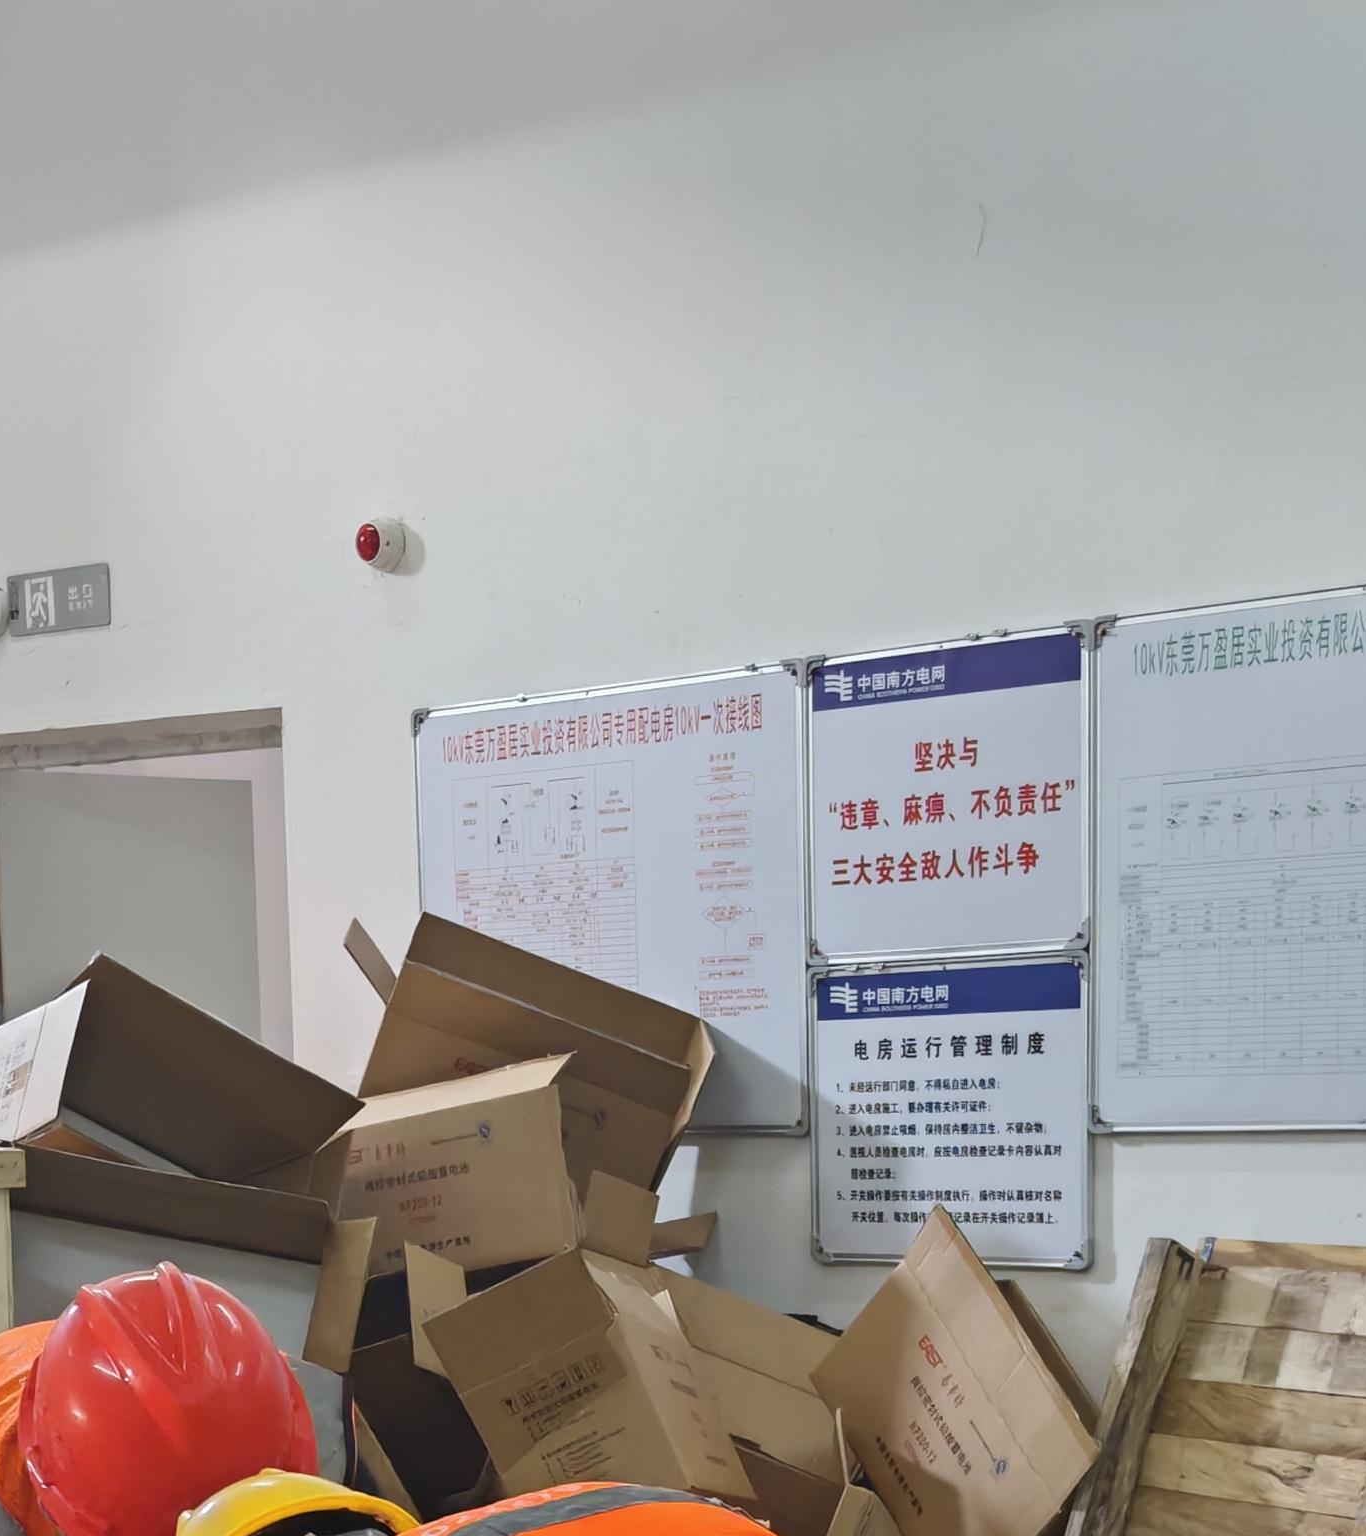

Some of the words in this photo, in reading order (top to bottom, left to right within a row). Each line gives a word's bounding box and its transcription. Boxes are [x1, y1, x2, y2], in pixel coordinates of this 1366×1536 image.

[857, 665, 946, 693] 中国南方电网
[913, 736, 979, 773] 坚决与
[831, 841, 1040, 886] 三大安全敌人作斗争
[862, 984, 949, 1006] 中国南方电网
[853, 1032, 1046, 1060] 电房运行管理制度
[918, 1334, 944, 1369] EAST
